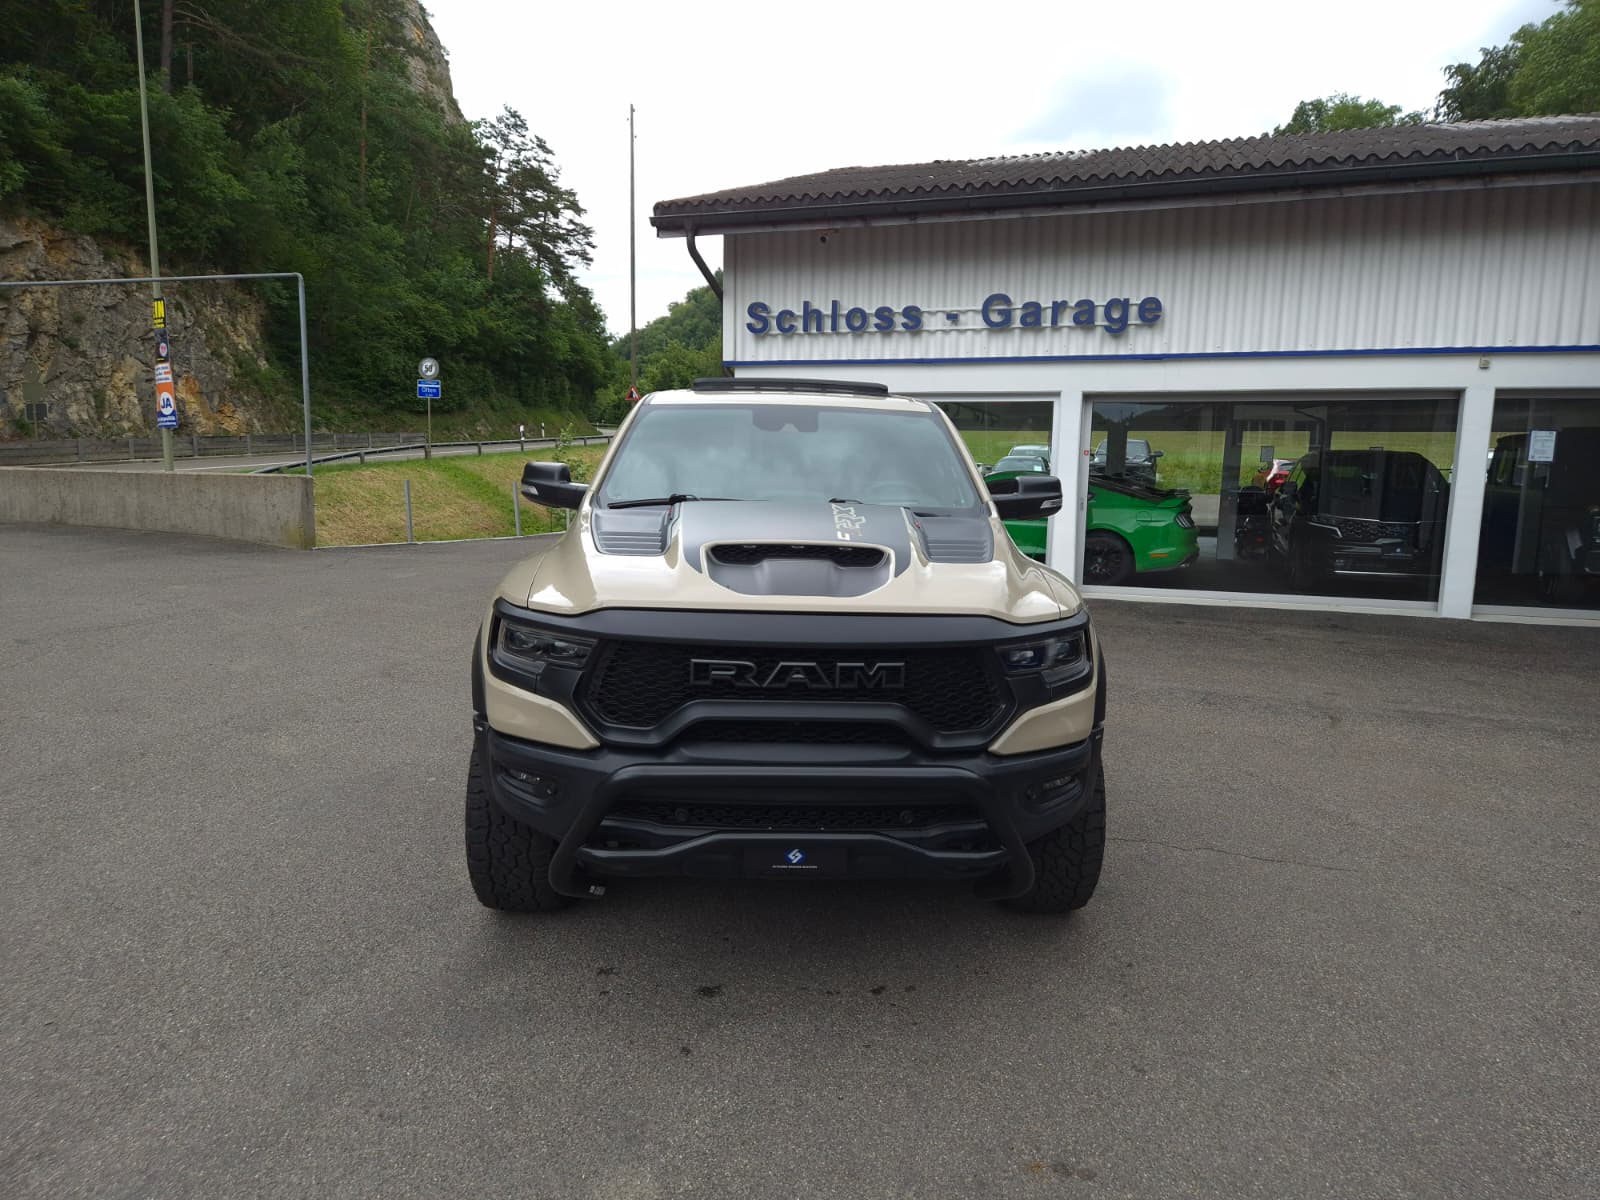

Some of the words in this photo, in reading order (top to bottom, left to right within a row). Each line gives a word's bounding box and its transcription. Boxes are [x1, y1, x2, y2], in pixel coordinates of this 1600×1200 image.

[746, 300, 923, 335] Schloss
[981, 293, 1163, 334] Garage
[161, 397, 173, 409] JA
[689, 658, 905, 689] RAM
